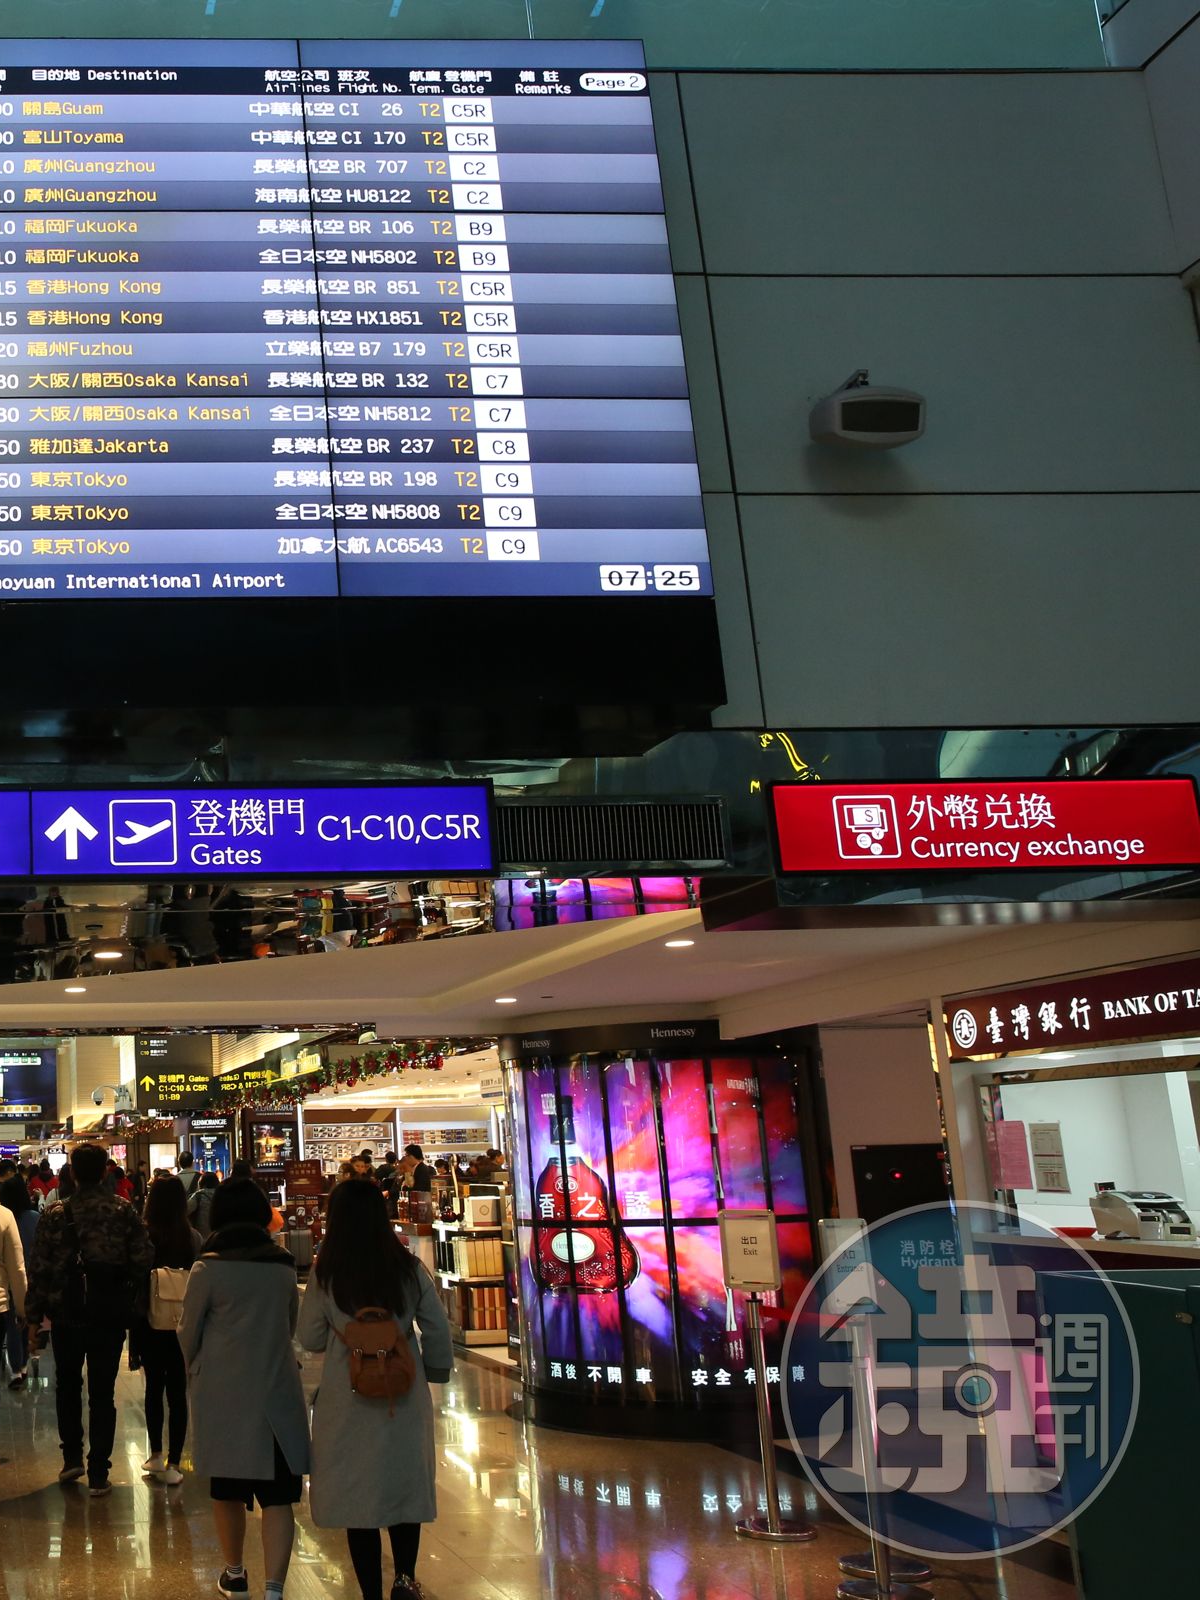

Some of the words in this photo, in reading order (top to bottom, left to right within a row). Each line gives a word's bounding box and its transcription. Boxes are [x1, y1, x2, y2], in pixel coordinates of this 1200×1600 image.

[32, 69, 80, 80] 目的地
[88, 69, 178, 81] Destination
[585, 78, 626, 89] Page
[630, 76, 640, 88] 2
[516, 83, 572, 94] Remarks
[23, 102, 103, 116] 關島Guam
[249, 102, 334, 117] 中華航空
[339, 103, 360, 116] CI
[382, 103, 402, 116] 26
[419, 103, 440, 117] T2
[452, 104, 486, 118] C5R
[24, 188, 156, 203] 廣州Guangzhou
[255, 188, 342, 204] 海南航空
[346, 188, 411, 203] HU8122
[428, 190, 450, 204] T2
[466, 190, 490, 205] C2
[25, 249, 139, 264] 福岡Fukuoka
[259, 249, 347, 265] 全日本空
[351, 250, 416, 264] NH5802
[434, 250, 456, 265] T2
[473, 252, 496, 266] B9
[30, 438, 168, 454] 雅加達Jakarta
[272, 438, 362, 454] 長榮航空
[368, 438, 390, 454] BR
[401, 438, 434, 454] 237
[452, 439, 474, 454] T2
[492, 440, 516, 456] C8
[32, 538, 130, 554] 東京Tokyo
[375, 538, 443, 554] AC6543
[461, 538, 484, 554] T2
[502, 540, 526, 554] C9
[66, 574, 200, 589] International
[213, 574, 285, 589] Airport
[608, 570, 693, 586] 07:25
[188, 798, 304, 837] 登機門
[318, 815, 480, 844] C1-C10,C5R
[190, 844, 262, 866] Gates
[910, 837, 1020, 863] Currency
[1028, 834, 1145, 861] exchange
[986, 997, 1091, 1044] 臺灣銀行
[1102, 996, 1152, 1020] BANK
[1154, 991, 1179, 1012] OF
[651, 1028, 696, 1038] Hennessy
[522, 1040, 550, 1048] Hennessy
[741, 1236, 758, 1245] 出口
[901, 1240, 956, 1256] 消防栓
[743, 1248, 758, 1256] Exit
[901, 1256, 956, 1269] Hydrant
[550, 1362, 652, 1385] 酒後不開車
[692, 1365, 805, 1386] 安全有保障
